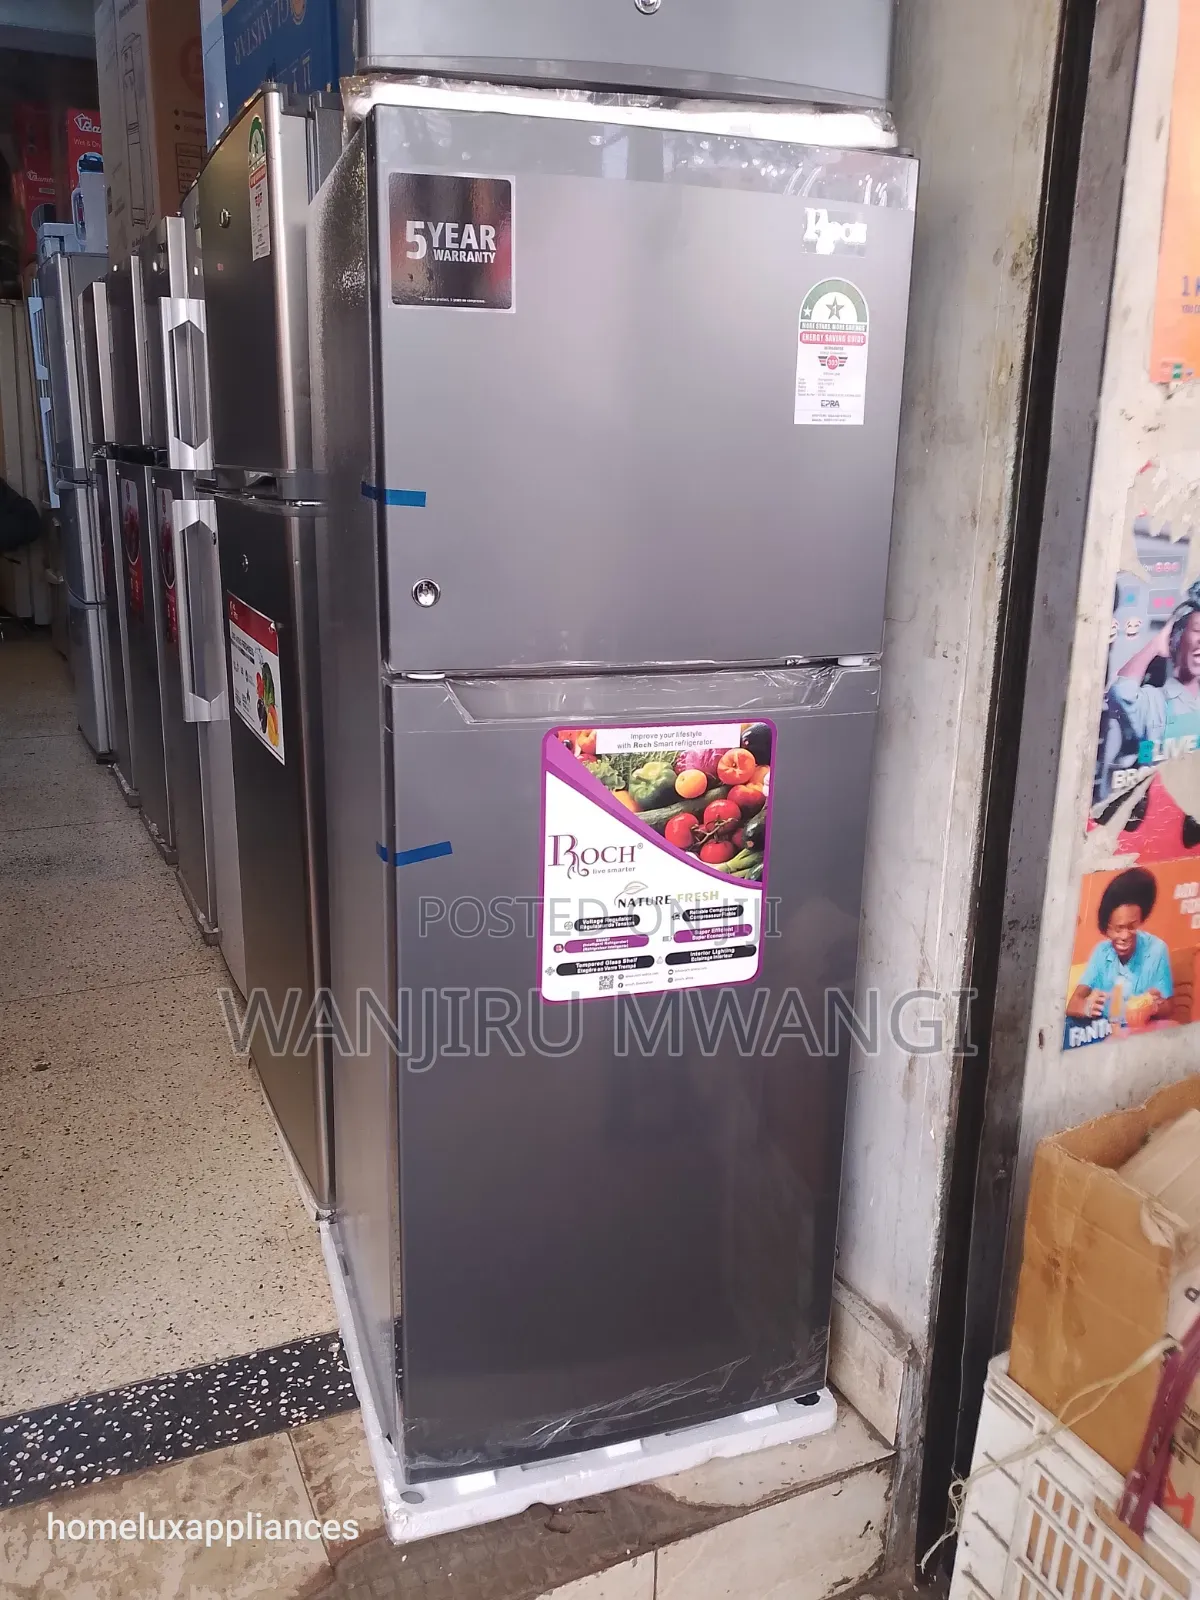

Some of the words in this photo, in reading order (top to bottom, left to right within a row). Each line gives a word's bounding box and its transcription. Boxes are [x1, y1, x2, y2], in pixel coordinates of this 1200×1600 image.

[426, 221, 497, 250] YEAR
[433, 249, 496, 264] WARRANTY
[802, 333, 824, 343] ENERGY
[824, 333, 847, 343] SAVING
[630, 732, 659, 742] Improve
[659, 732, 676, 741] your
[675, 730, 703, 740] lifestyle
[617, 741, 632, 749] with
[633, 741, 652, 749] Roch
[653, 740, 674, 748] Smart
[592, 867, 606, 875] live
[607, 865, 636, 874] smarter
[617, 894, 672, 909] NATURE
[676, 890, 719, 903] FRESH
